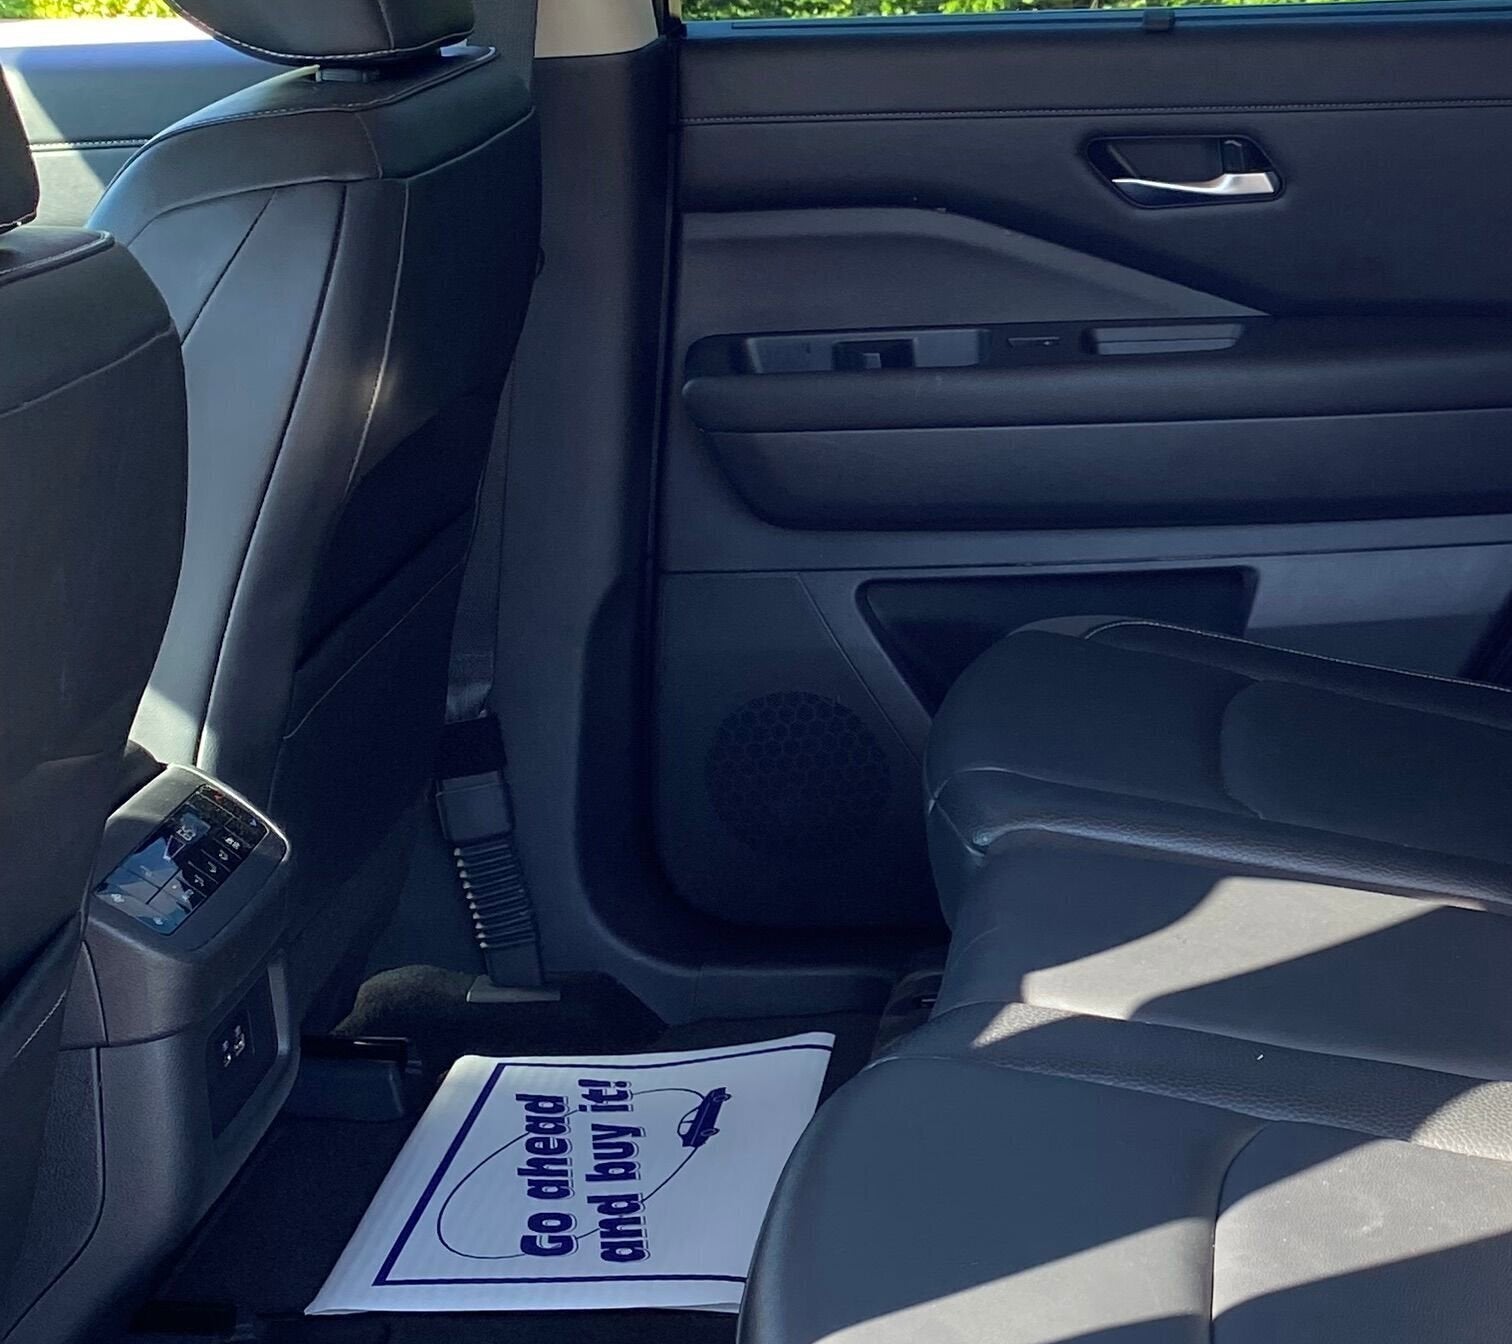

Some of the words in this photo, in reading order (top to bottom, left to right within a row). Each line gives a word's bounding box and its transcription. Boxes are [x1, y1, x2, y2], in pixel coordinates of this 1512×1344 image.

[578, 1078, 633, 1114] it!
[515, 1093, 575, 1200] ahead
[585, 1123, 646, 1183] buy
[520, 1211, 579, 1258] Go
[586, 1192, 651, 1264] and
